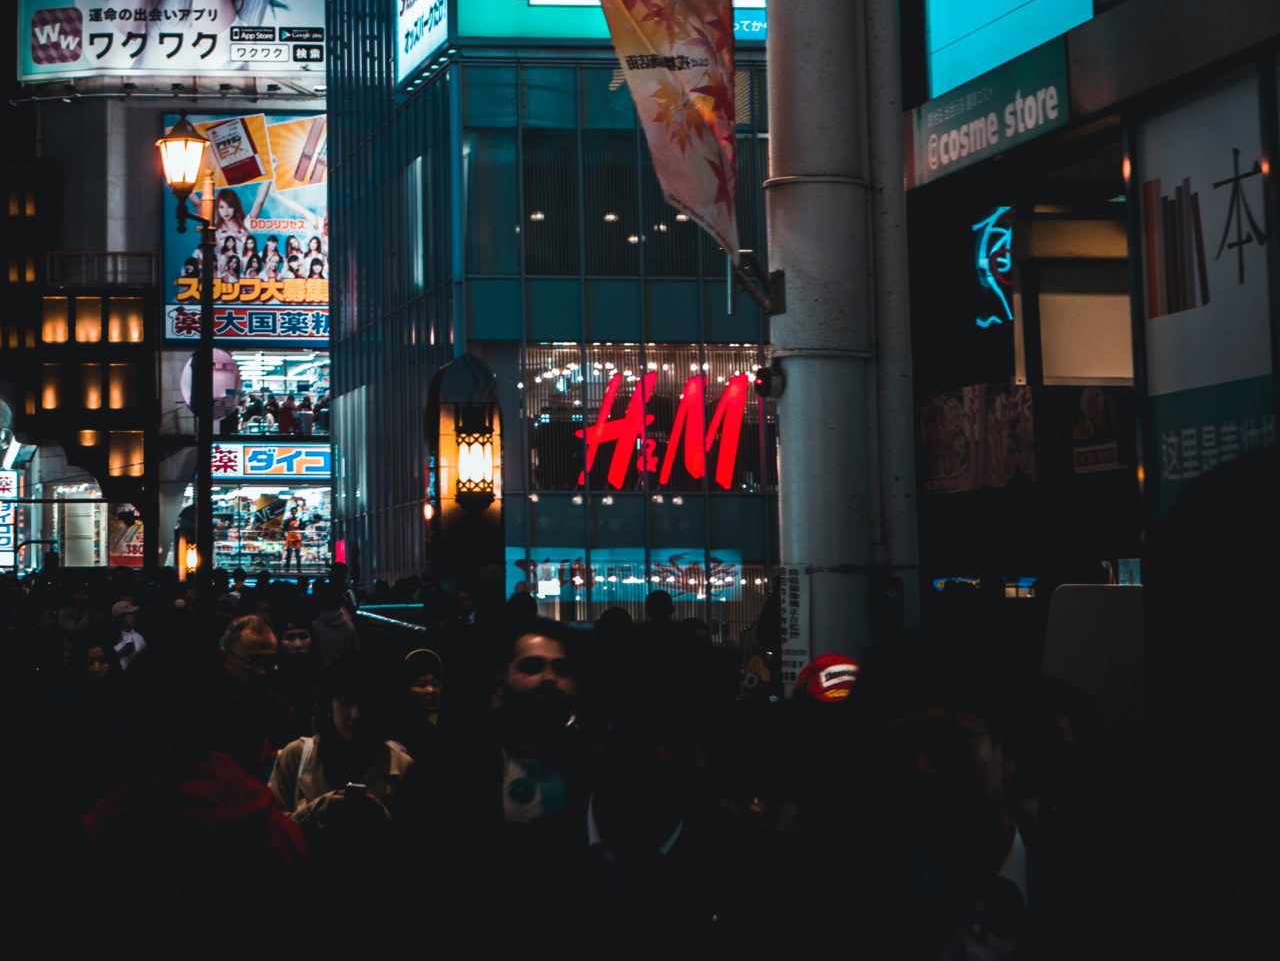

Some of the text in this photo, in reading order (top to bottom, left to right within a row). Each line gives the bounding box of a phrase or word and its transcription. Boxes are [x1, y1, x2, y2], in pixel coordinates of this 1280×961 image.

[89, 8, 219, 23] 運命の出会いアプリ
[89, 31, 219, 59] ワクワク
[241, 32, 273, 40] App Store
[237, 47, 321, 59] ワクワク 検索
[928, 111, 1000, 170] @cosme
[1005, 83, 1060, 137] store
[575, 371, 749, 490] H&M
